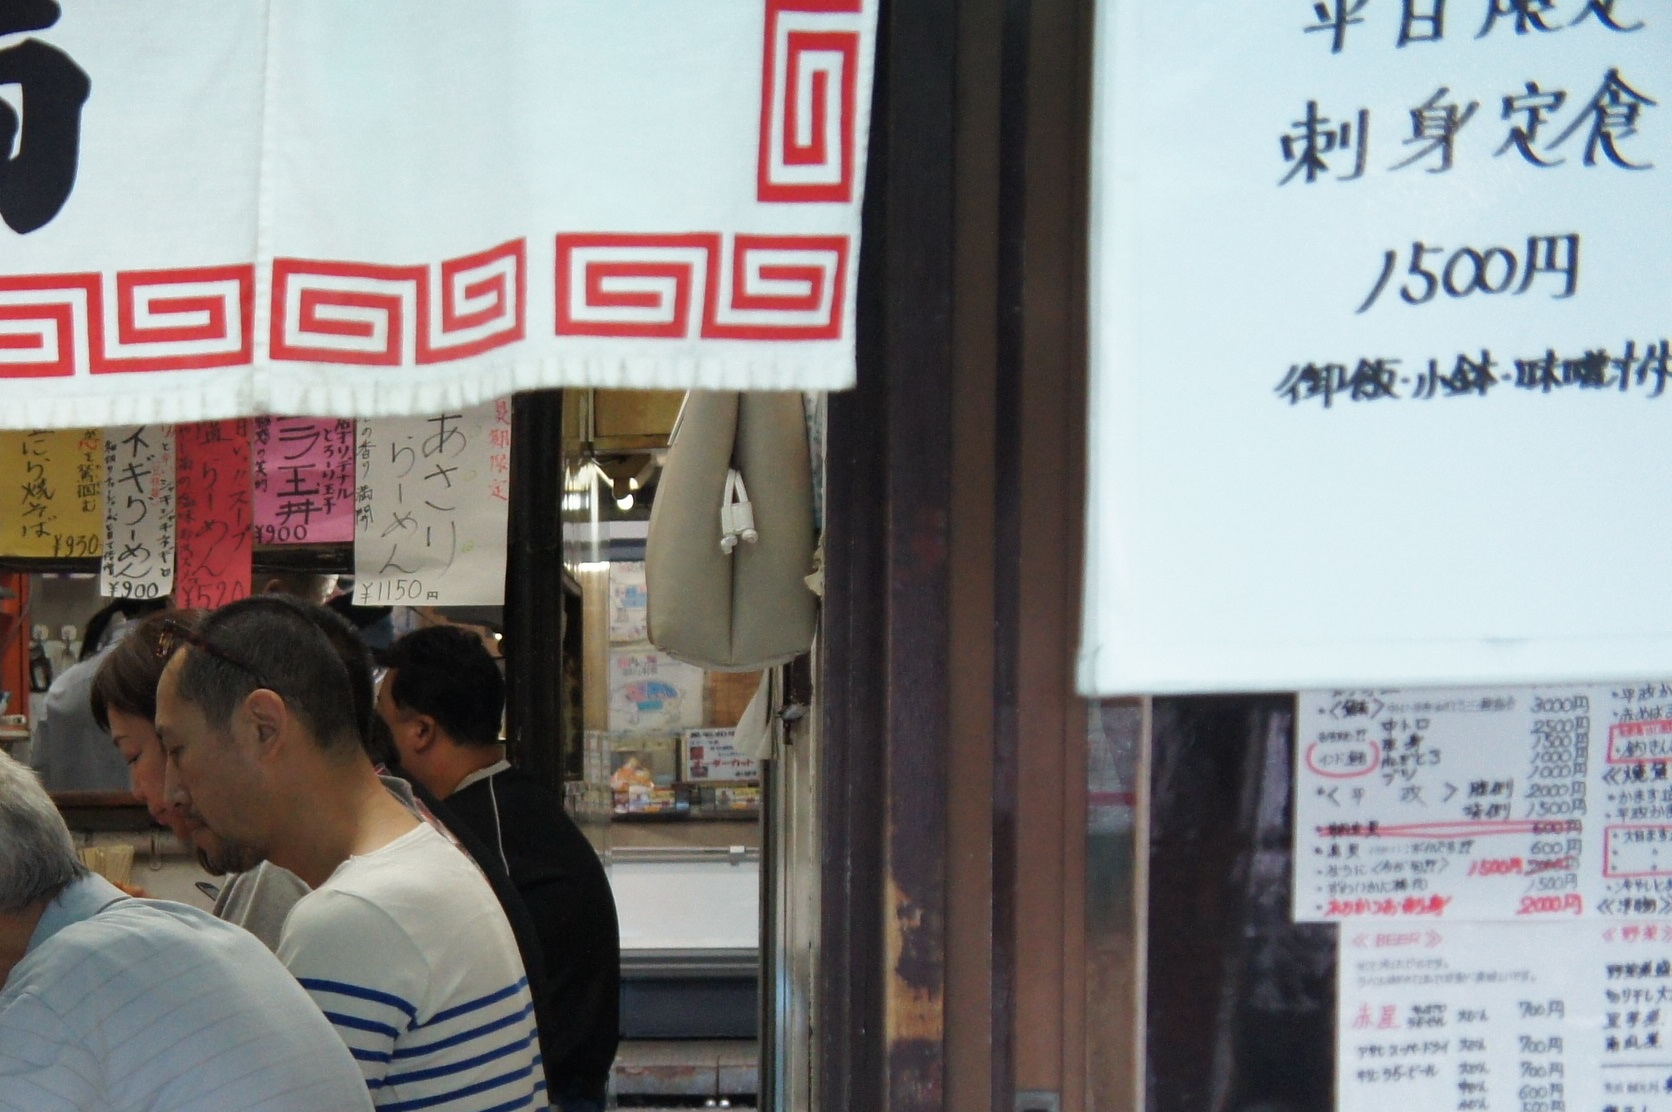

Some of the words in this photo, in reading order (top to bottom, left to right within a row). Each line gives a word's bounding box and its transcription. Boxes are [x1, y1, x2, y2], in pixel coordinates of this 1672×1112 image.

[1276, 66, 1658, 186] 刺身定食
[1354, 233, 1580, 314] 1500円
[22, 427, 58, 538] にら焼そば
[254, 524, 308, 544] ¥900
